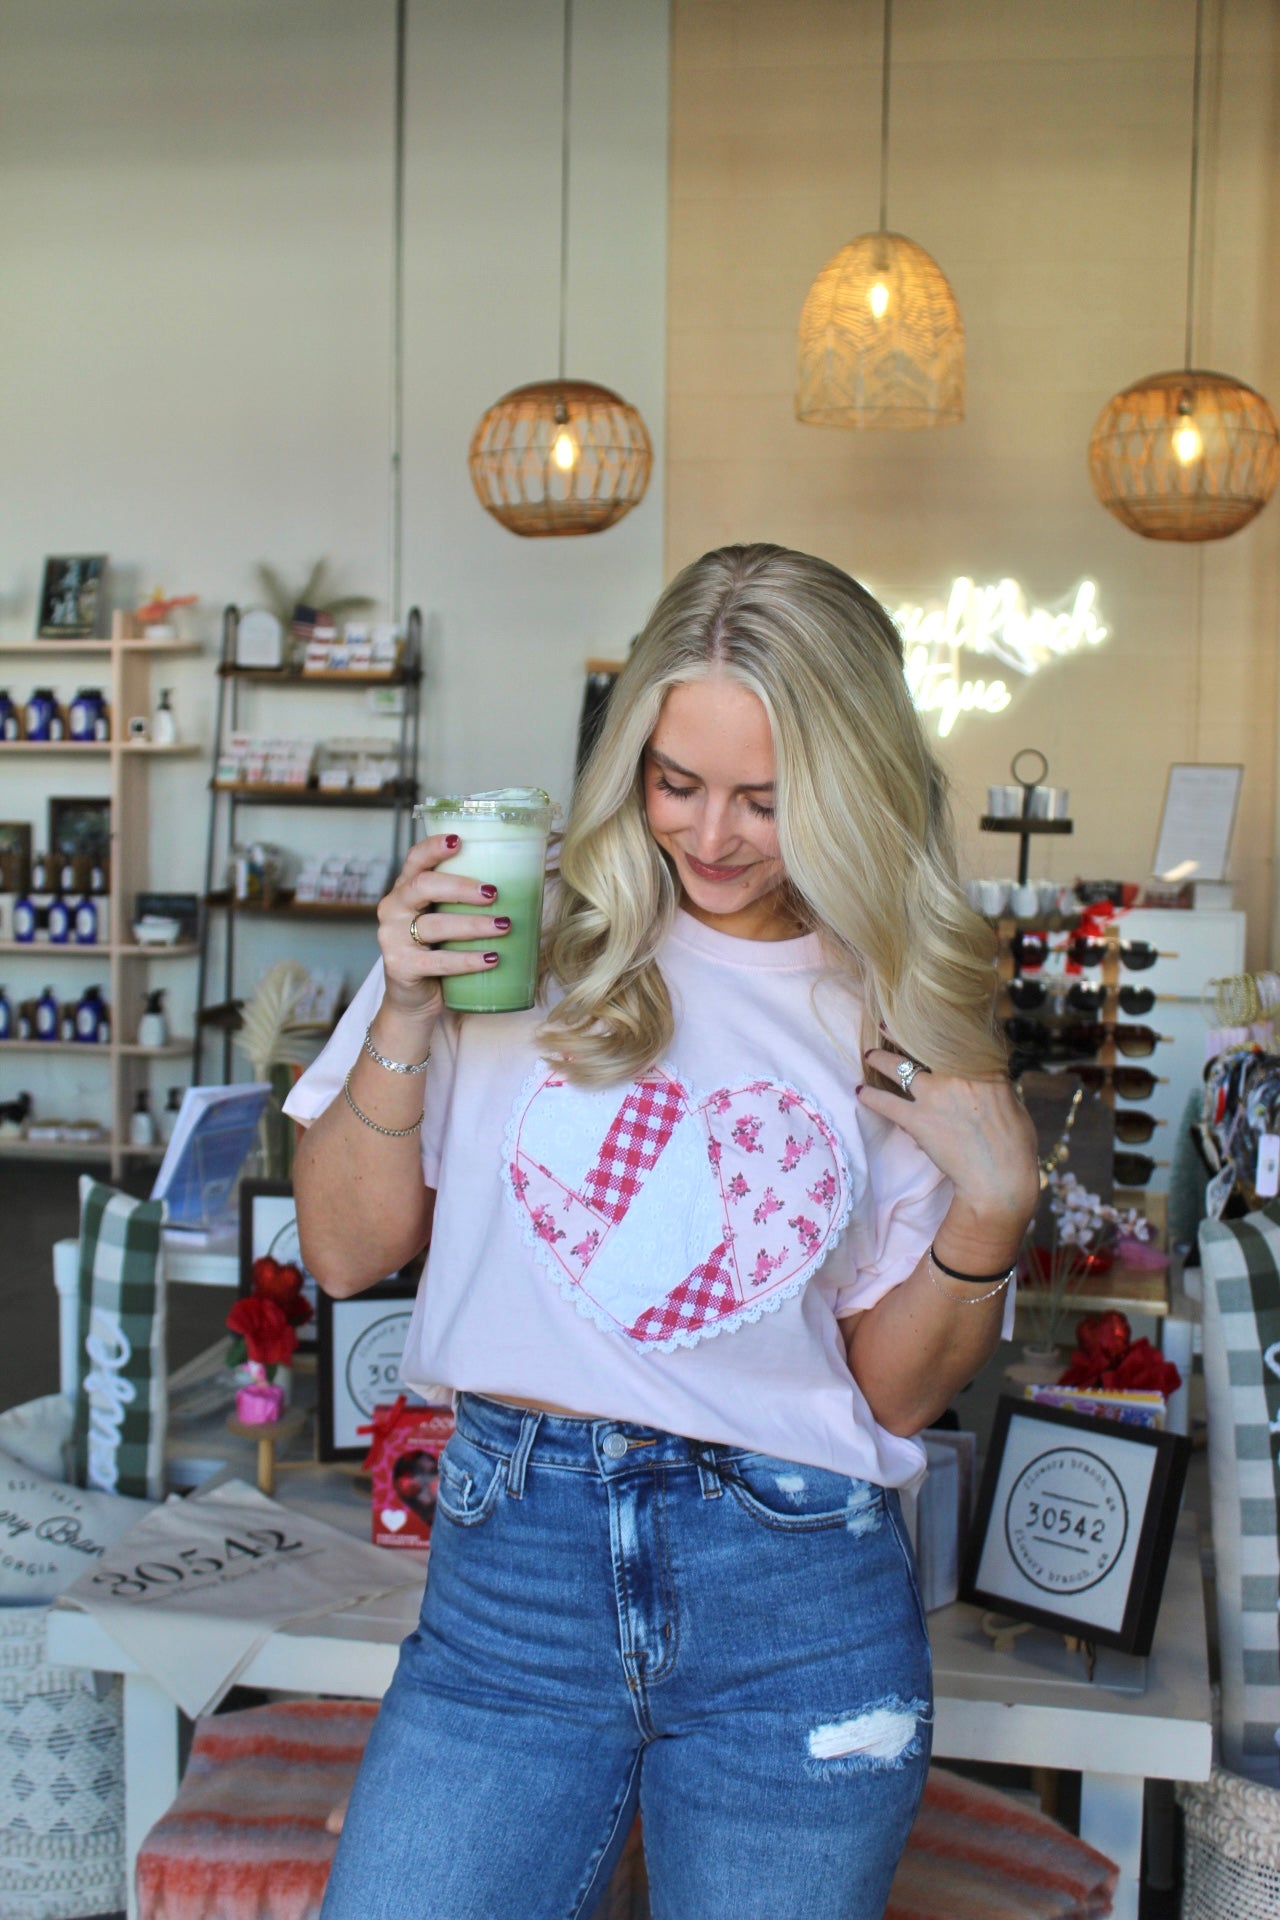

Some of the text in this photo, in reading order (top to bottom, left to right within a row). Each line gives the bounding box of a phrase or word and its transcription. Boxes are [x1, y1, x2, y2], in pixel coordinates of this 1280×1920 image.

[903, 645, 1012, 737] tique
[35, 1515, 105, 1558] Bran
[1025, 1501, 1106, 1543] 30542
[1, 1554, 58, 1577] ORGIA
[92, 1529, 302, 1596] 30542
